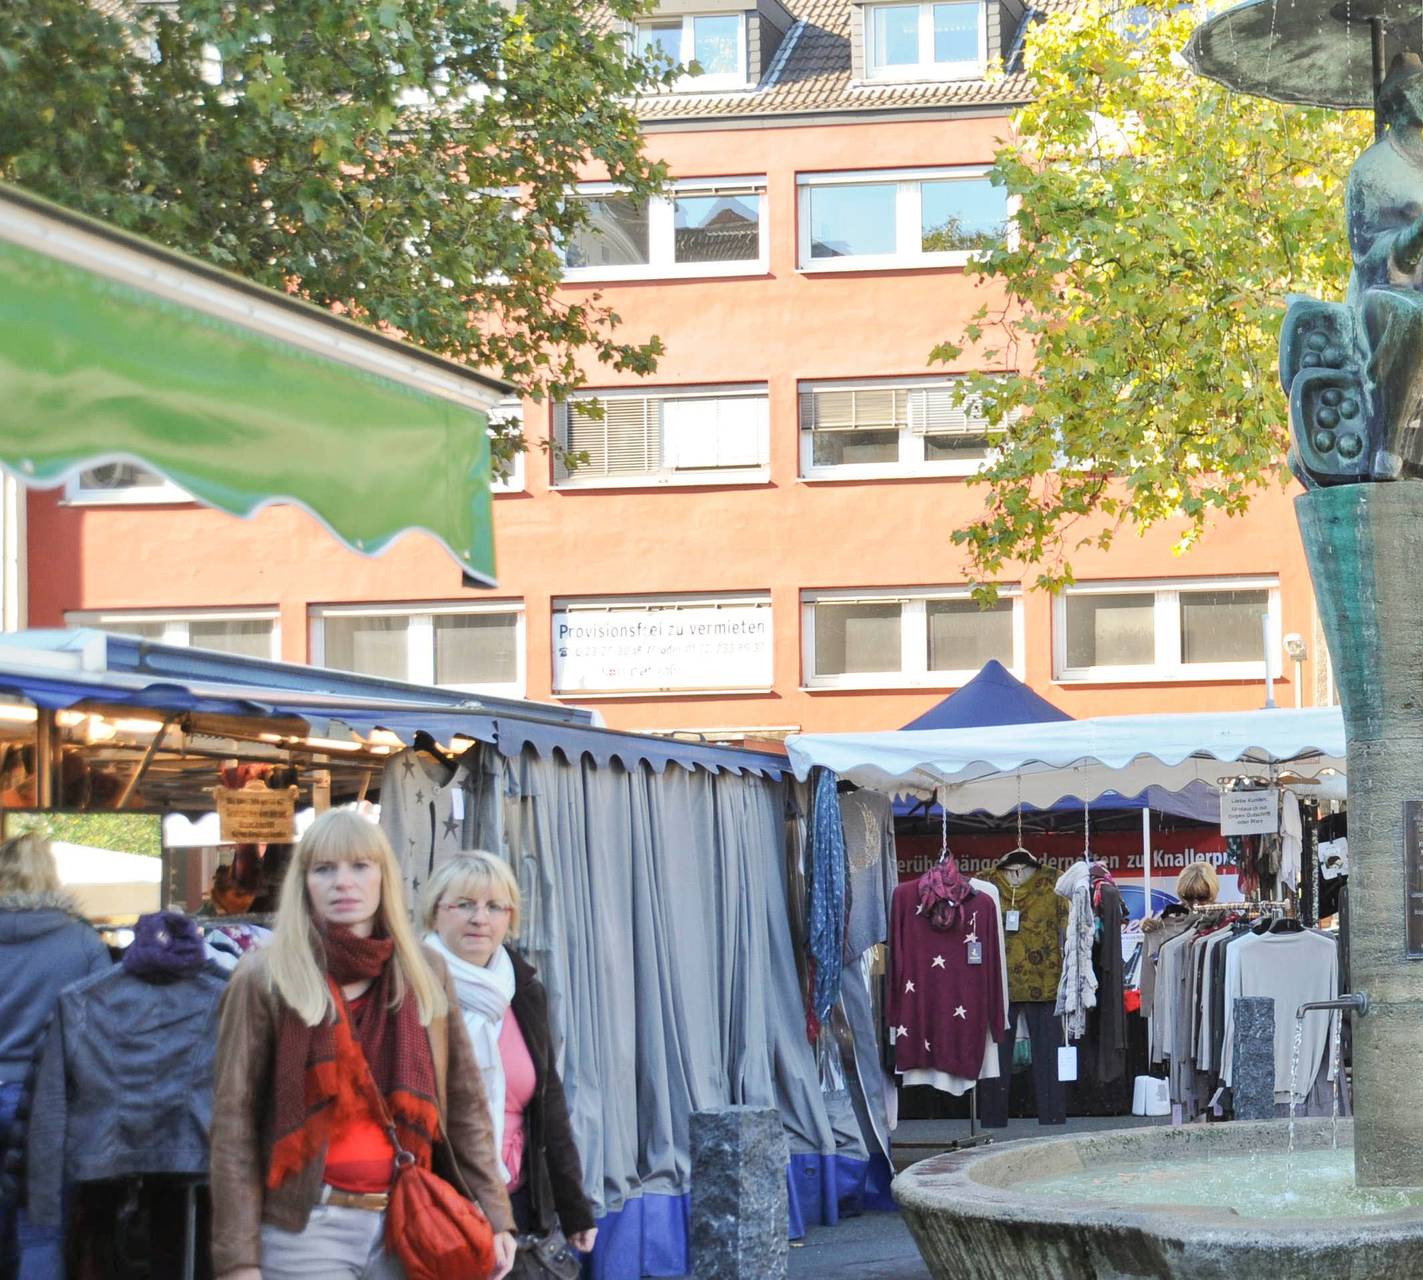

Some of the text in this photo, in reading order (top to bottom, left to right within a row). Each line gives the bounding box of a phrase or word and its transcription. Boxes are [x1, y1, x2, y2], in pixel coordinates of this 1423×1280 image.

[668, 624, 684, 636] zu
[690, 620, 765, 636] vermieten
[1127, 854, 1145, 868] zu
